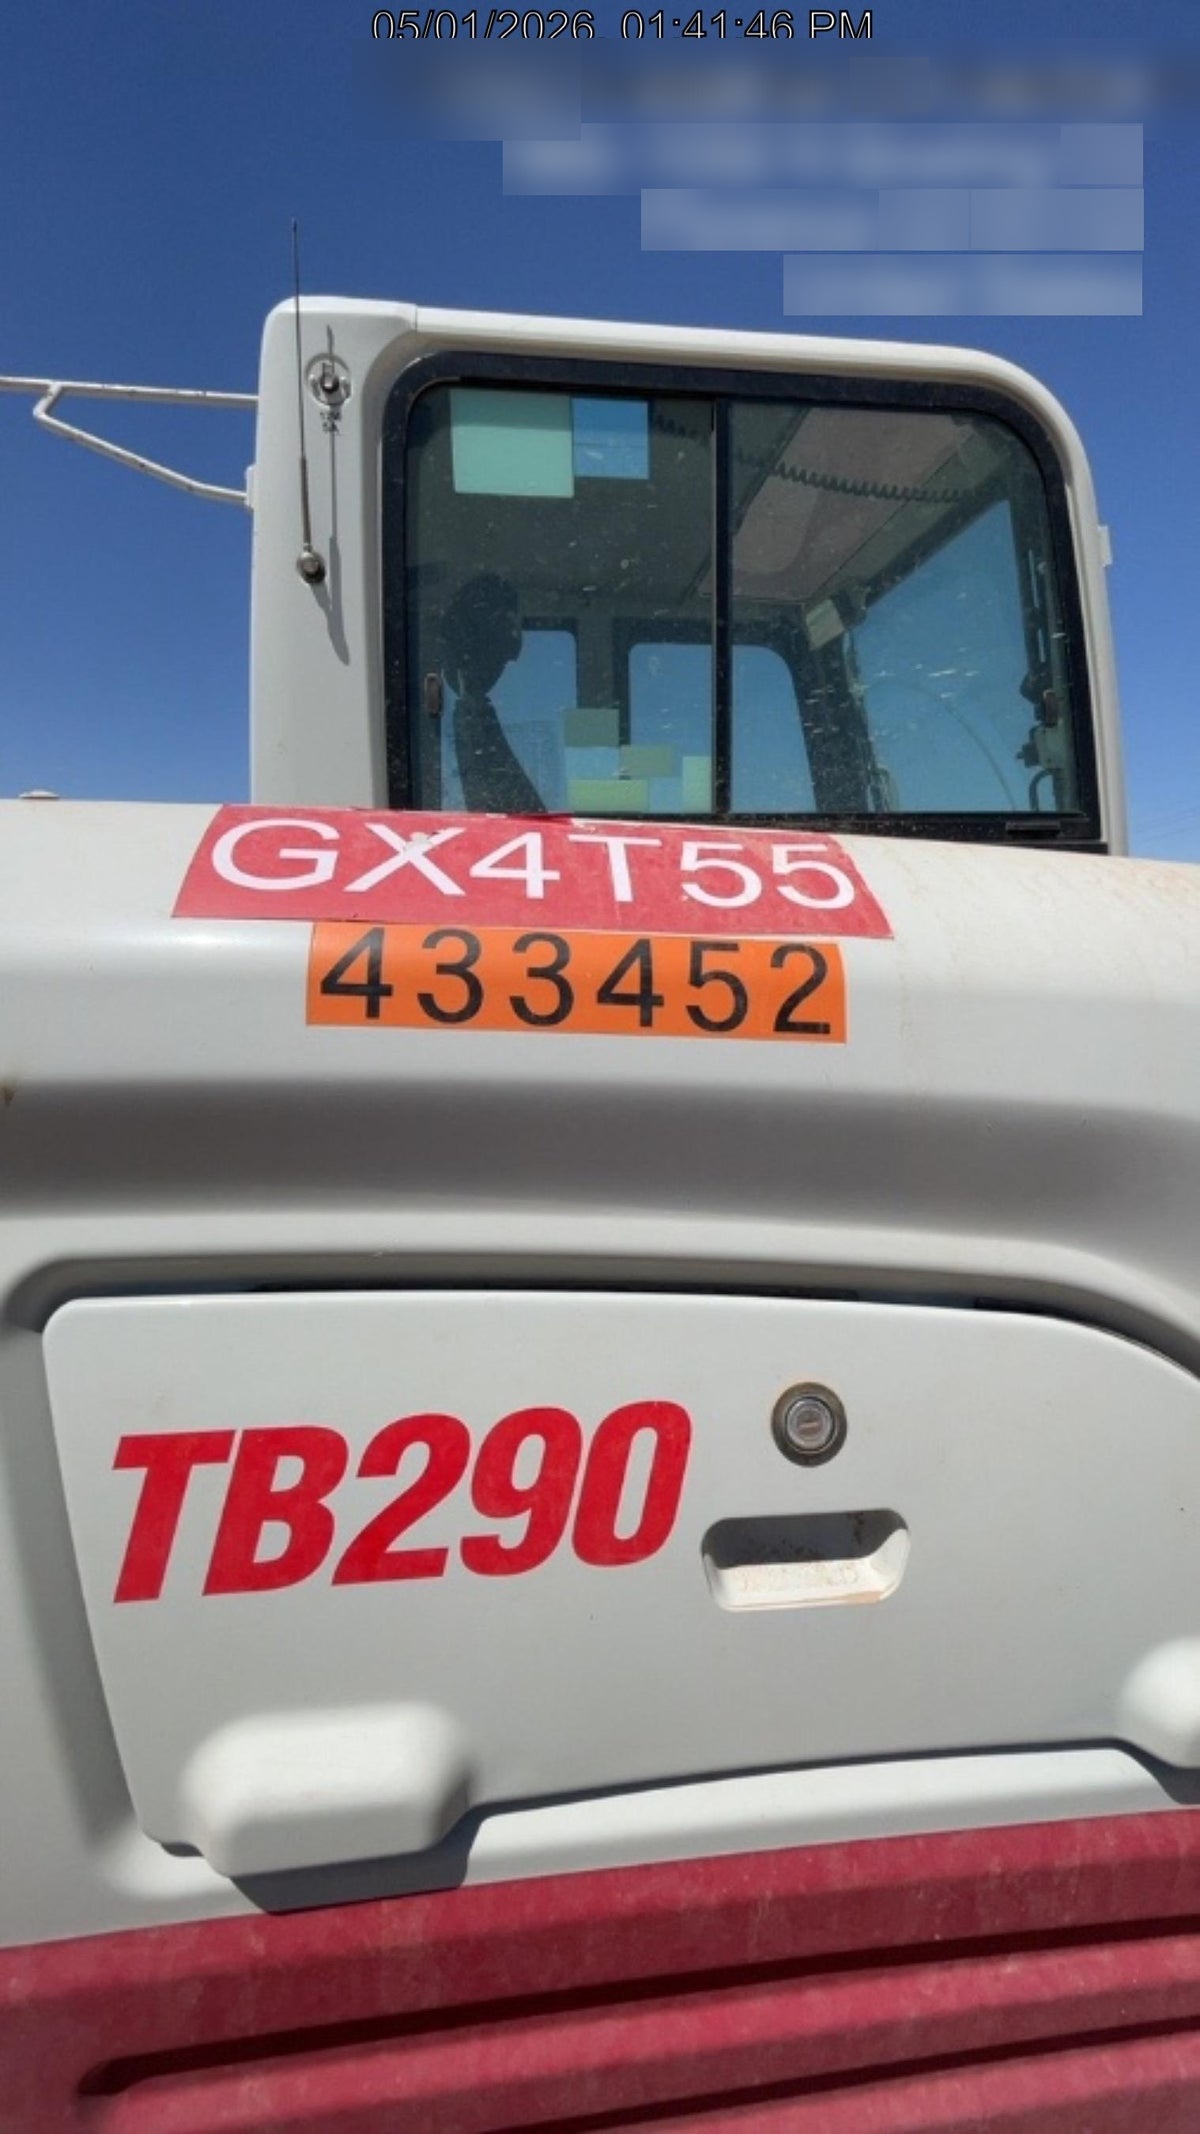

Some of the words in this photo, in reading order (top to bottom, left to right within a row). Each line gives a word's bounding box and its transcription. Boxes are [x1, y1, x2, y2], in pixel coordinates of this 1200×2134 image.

[211, 818, 855, 910] GX4T55
[319, 926, 832, 1036] 433452
[112, 1400, 693, 1604] TB290
